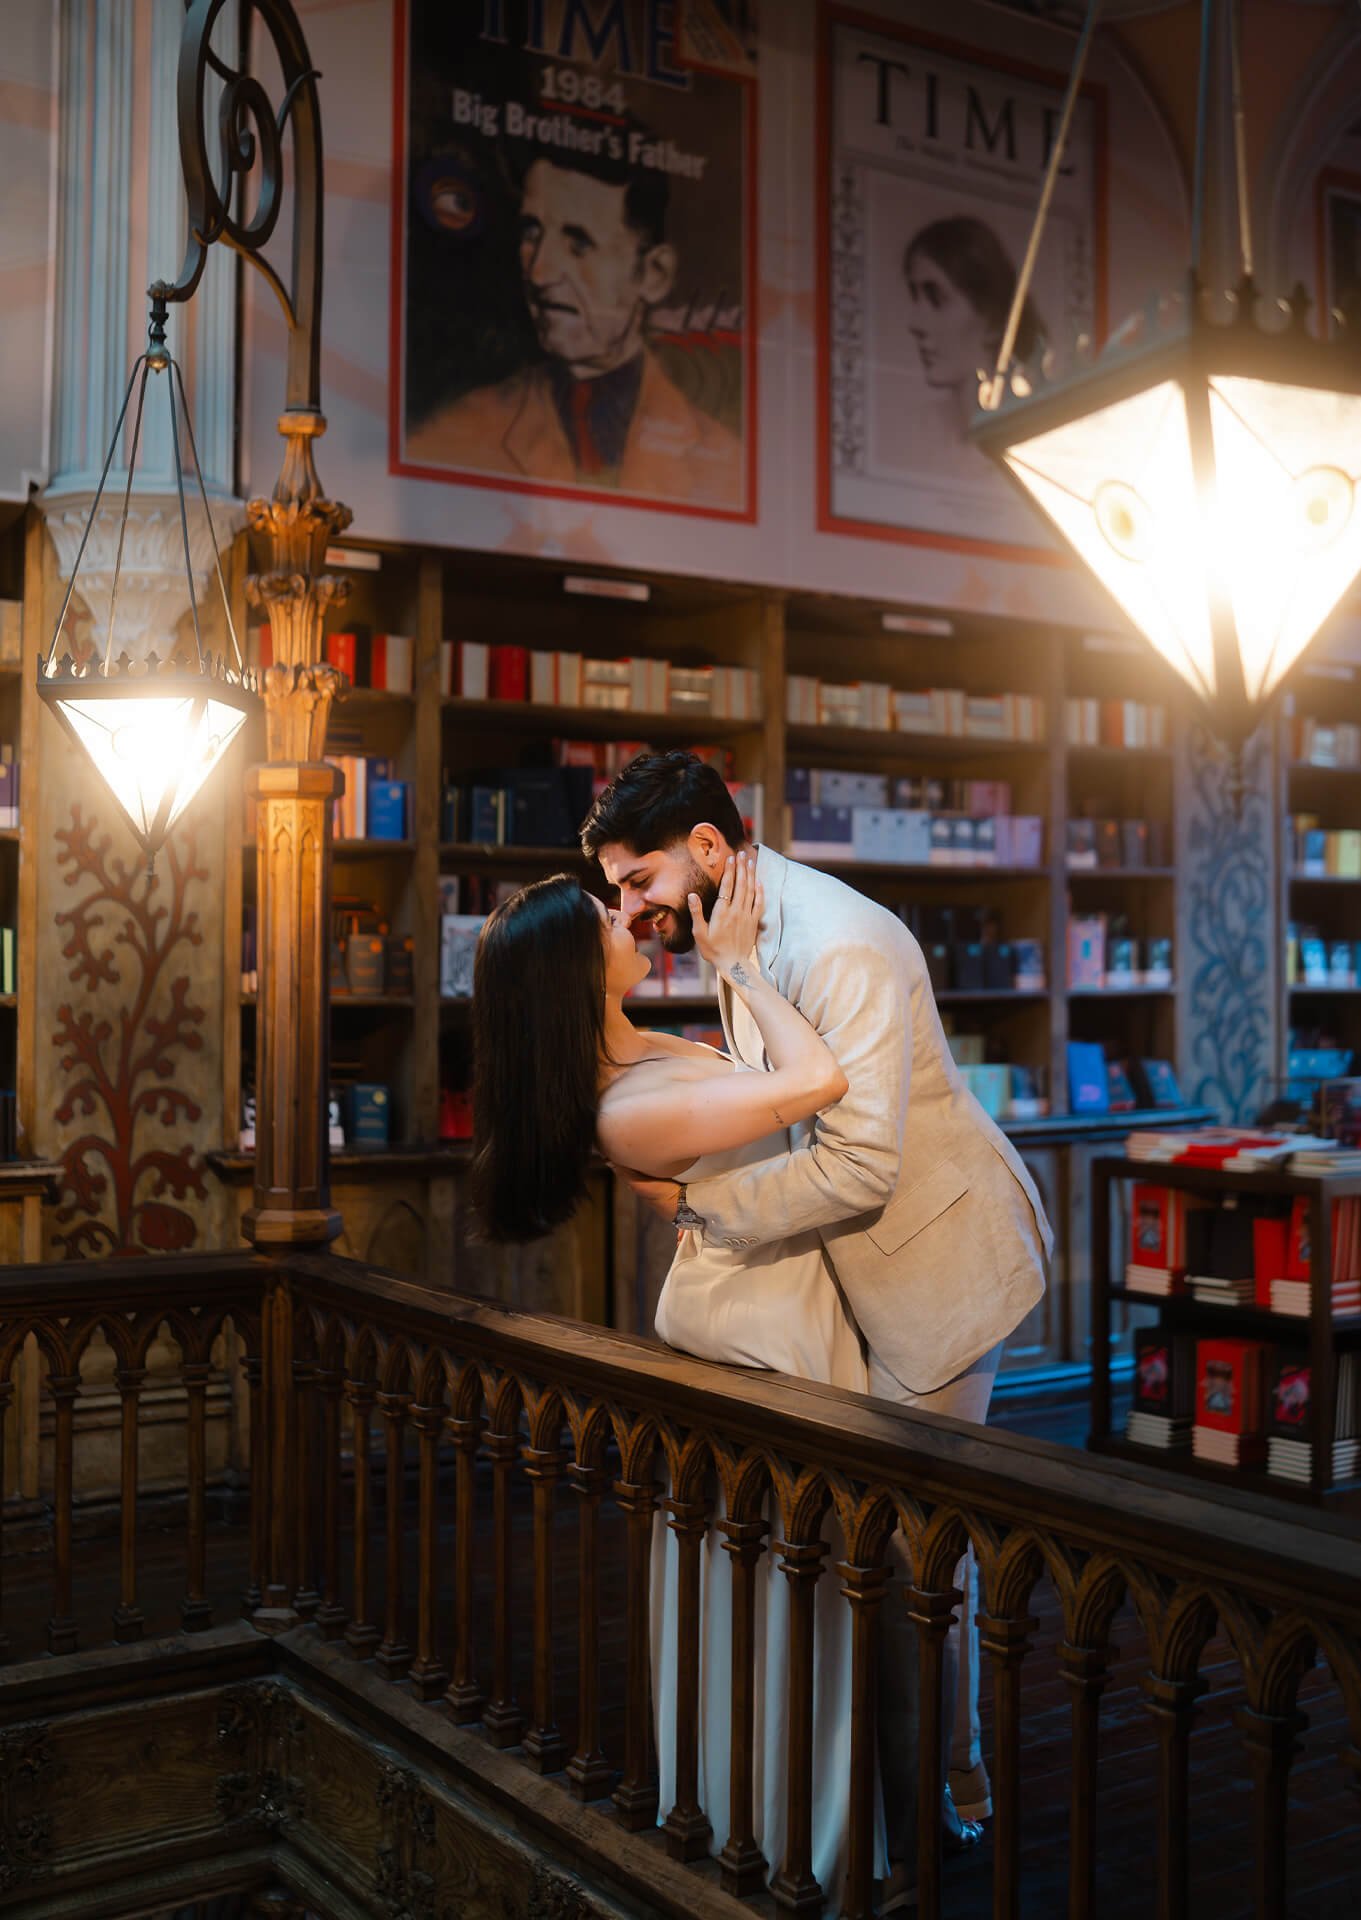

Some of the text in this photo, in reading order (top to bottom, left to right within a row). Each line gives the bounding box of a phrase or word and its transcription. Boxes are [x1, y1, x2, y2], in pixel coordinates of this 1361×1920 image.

[540, 66, 626, 115] 1984
[451, 88, 707, 180] Big Brother's Father
